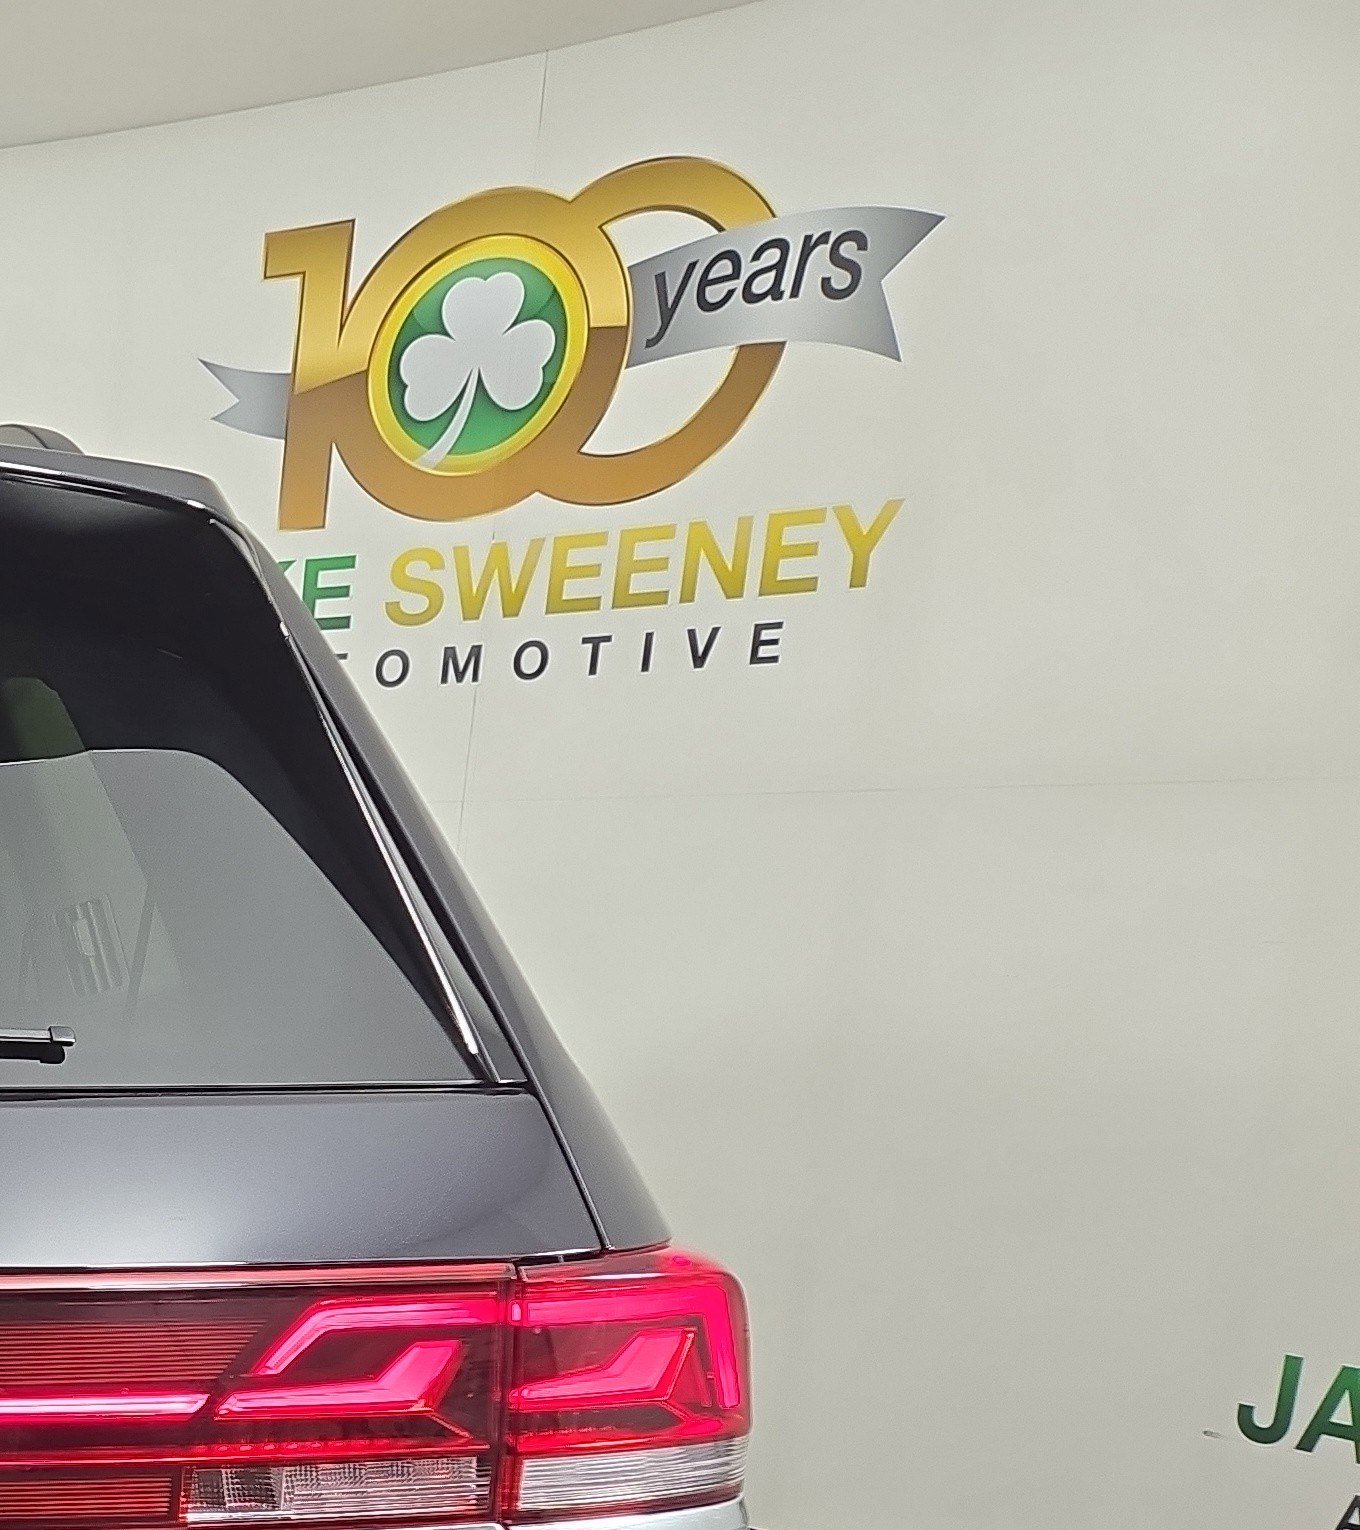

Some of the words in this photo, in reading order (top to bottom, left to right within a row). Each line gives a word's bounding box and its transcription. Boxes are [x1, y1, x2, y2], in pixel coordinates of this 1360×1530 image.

[643, 224, 869, 351] years
[383, 498, 906, 628] SWEENEY
[335, 620, 785, 689] OMOTIVE
